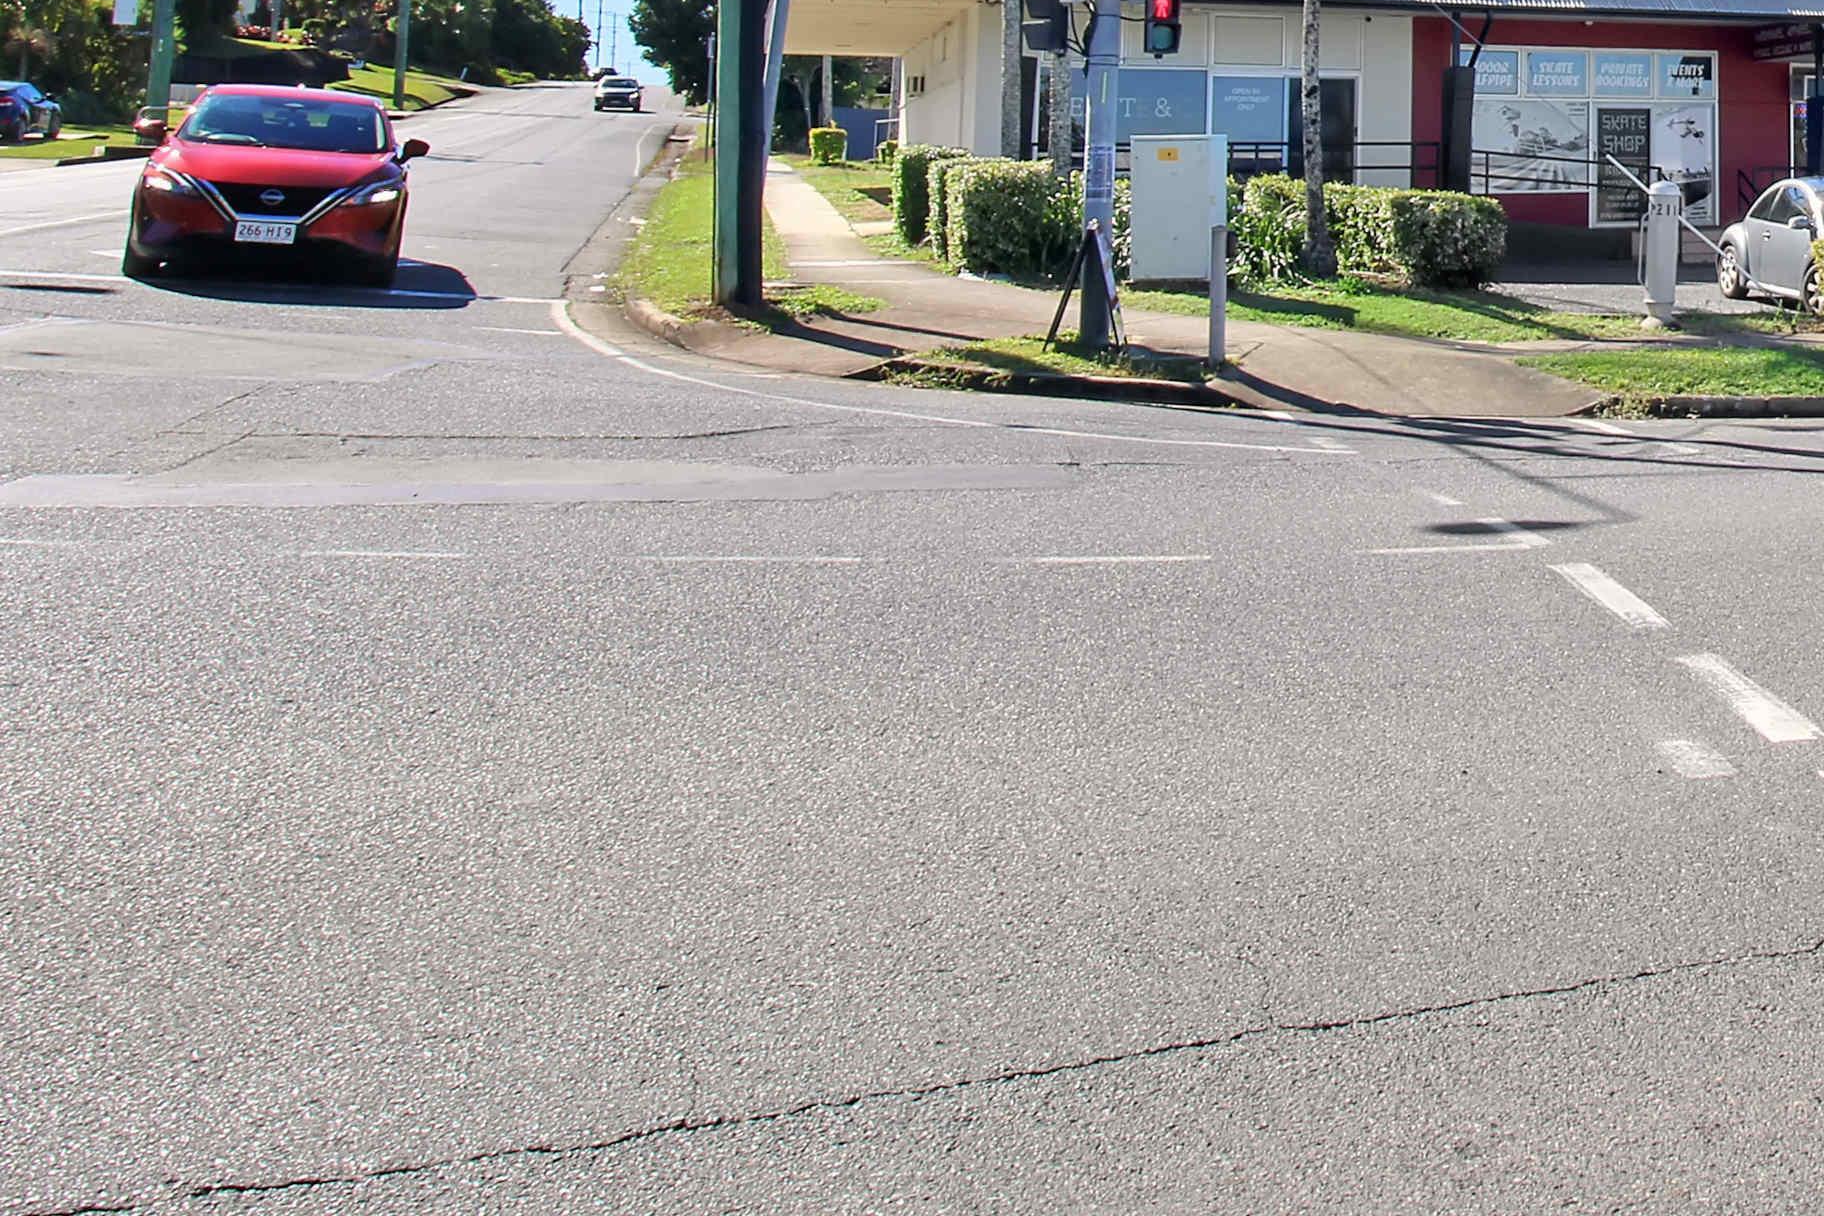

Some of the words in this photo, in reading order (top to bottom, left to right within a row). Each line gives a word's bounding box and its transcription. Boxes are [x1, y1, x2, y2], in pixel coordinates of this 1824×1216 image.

[1539, 62, 1575, 74] SKATE
[1666, 64, 1704, 76] EVENTS
[1602, 114, 1647, 130] SKATE
[1603, 134, 1645, 153] SHOP
[239, 224, 261, 236] 266
